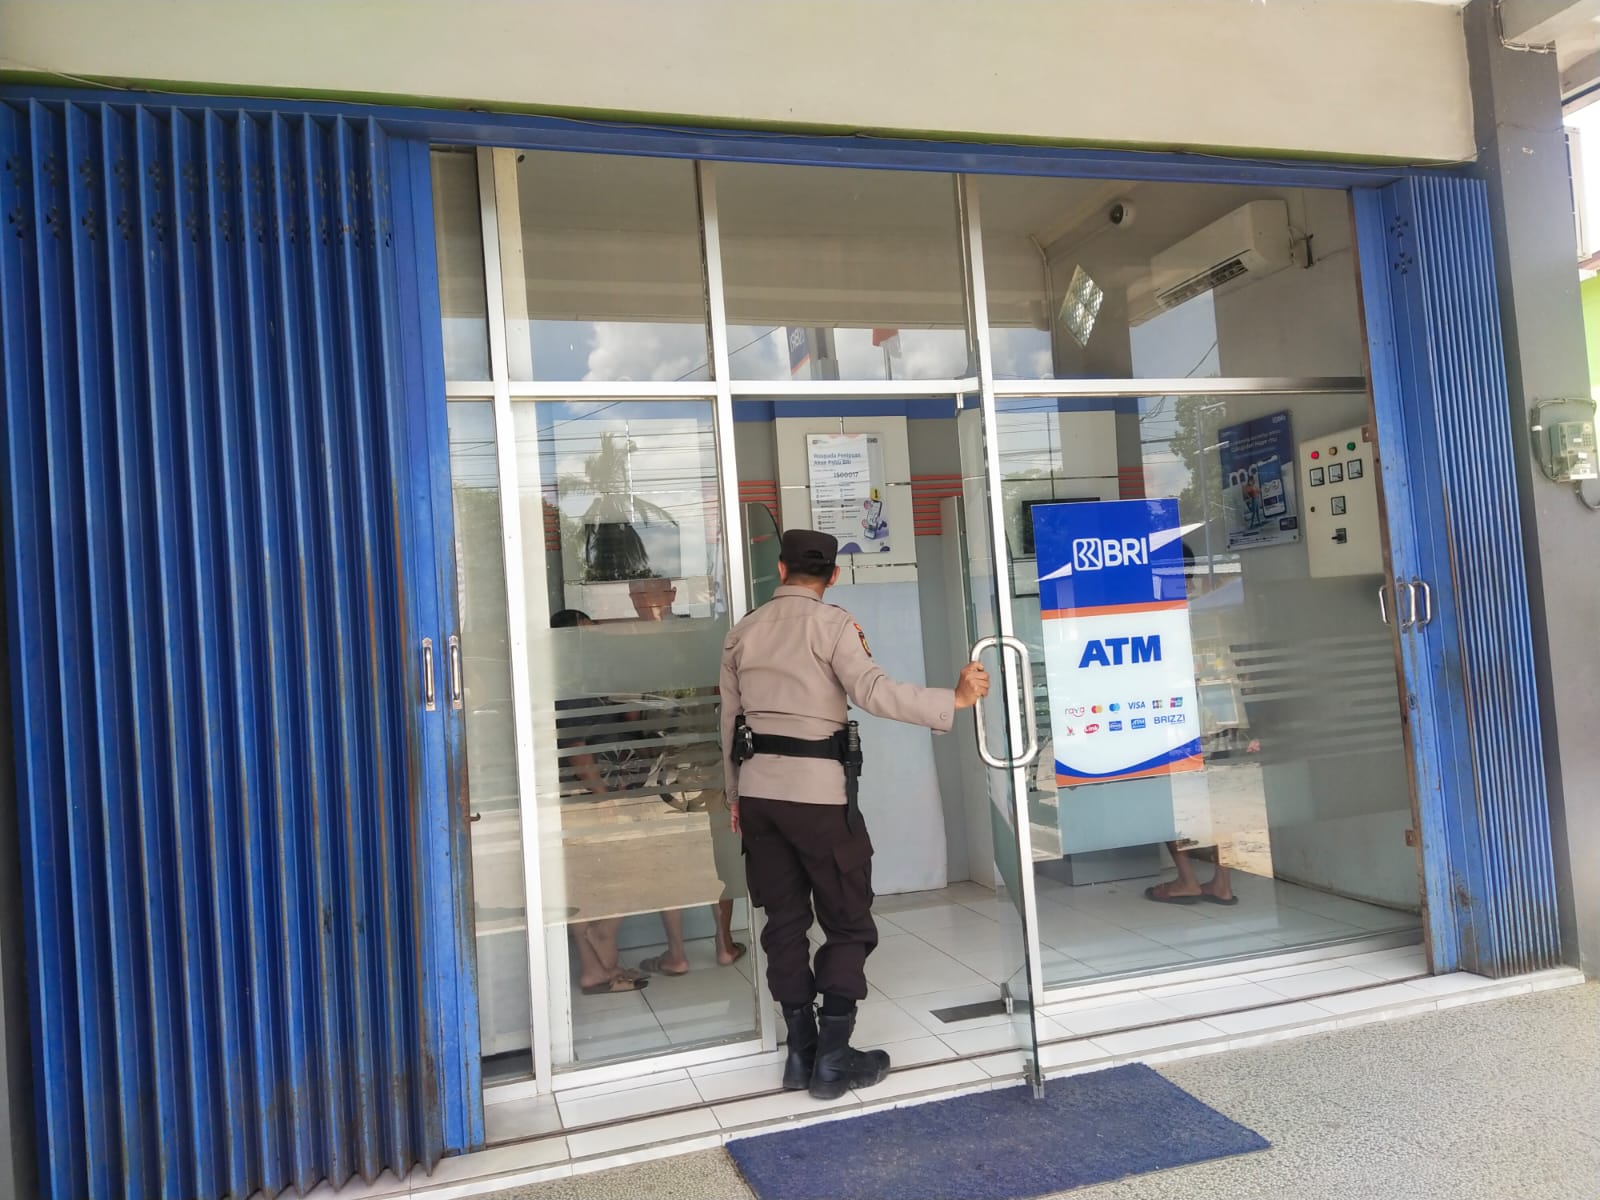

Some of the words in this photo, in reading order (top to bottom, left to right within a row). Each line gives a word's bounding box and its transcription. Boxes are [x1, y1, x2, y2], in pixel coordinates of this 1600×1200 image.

[1103, 537, 1148, 567] BRI
[1078, 634, 1162, 669] ATM
[1128, 701, 1146, 710] VISA
[1154, 714, 1185, 724] BRIZZI
